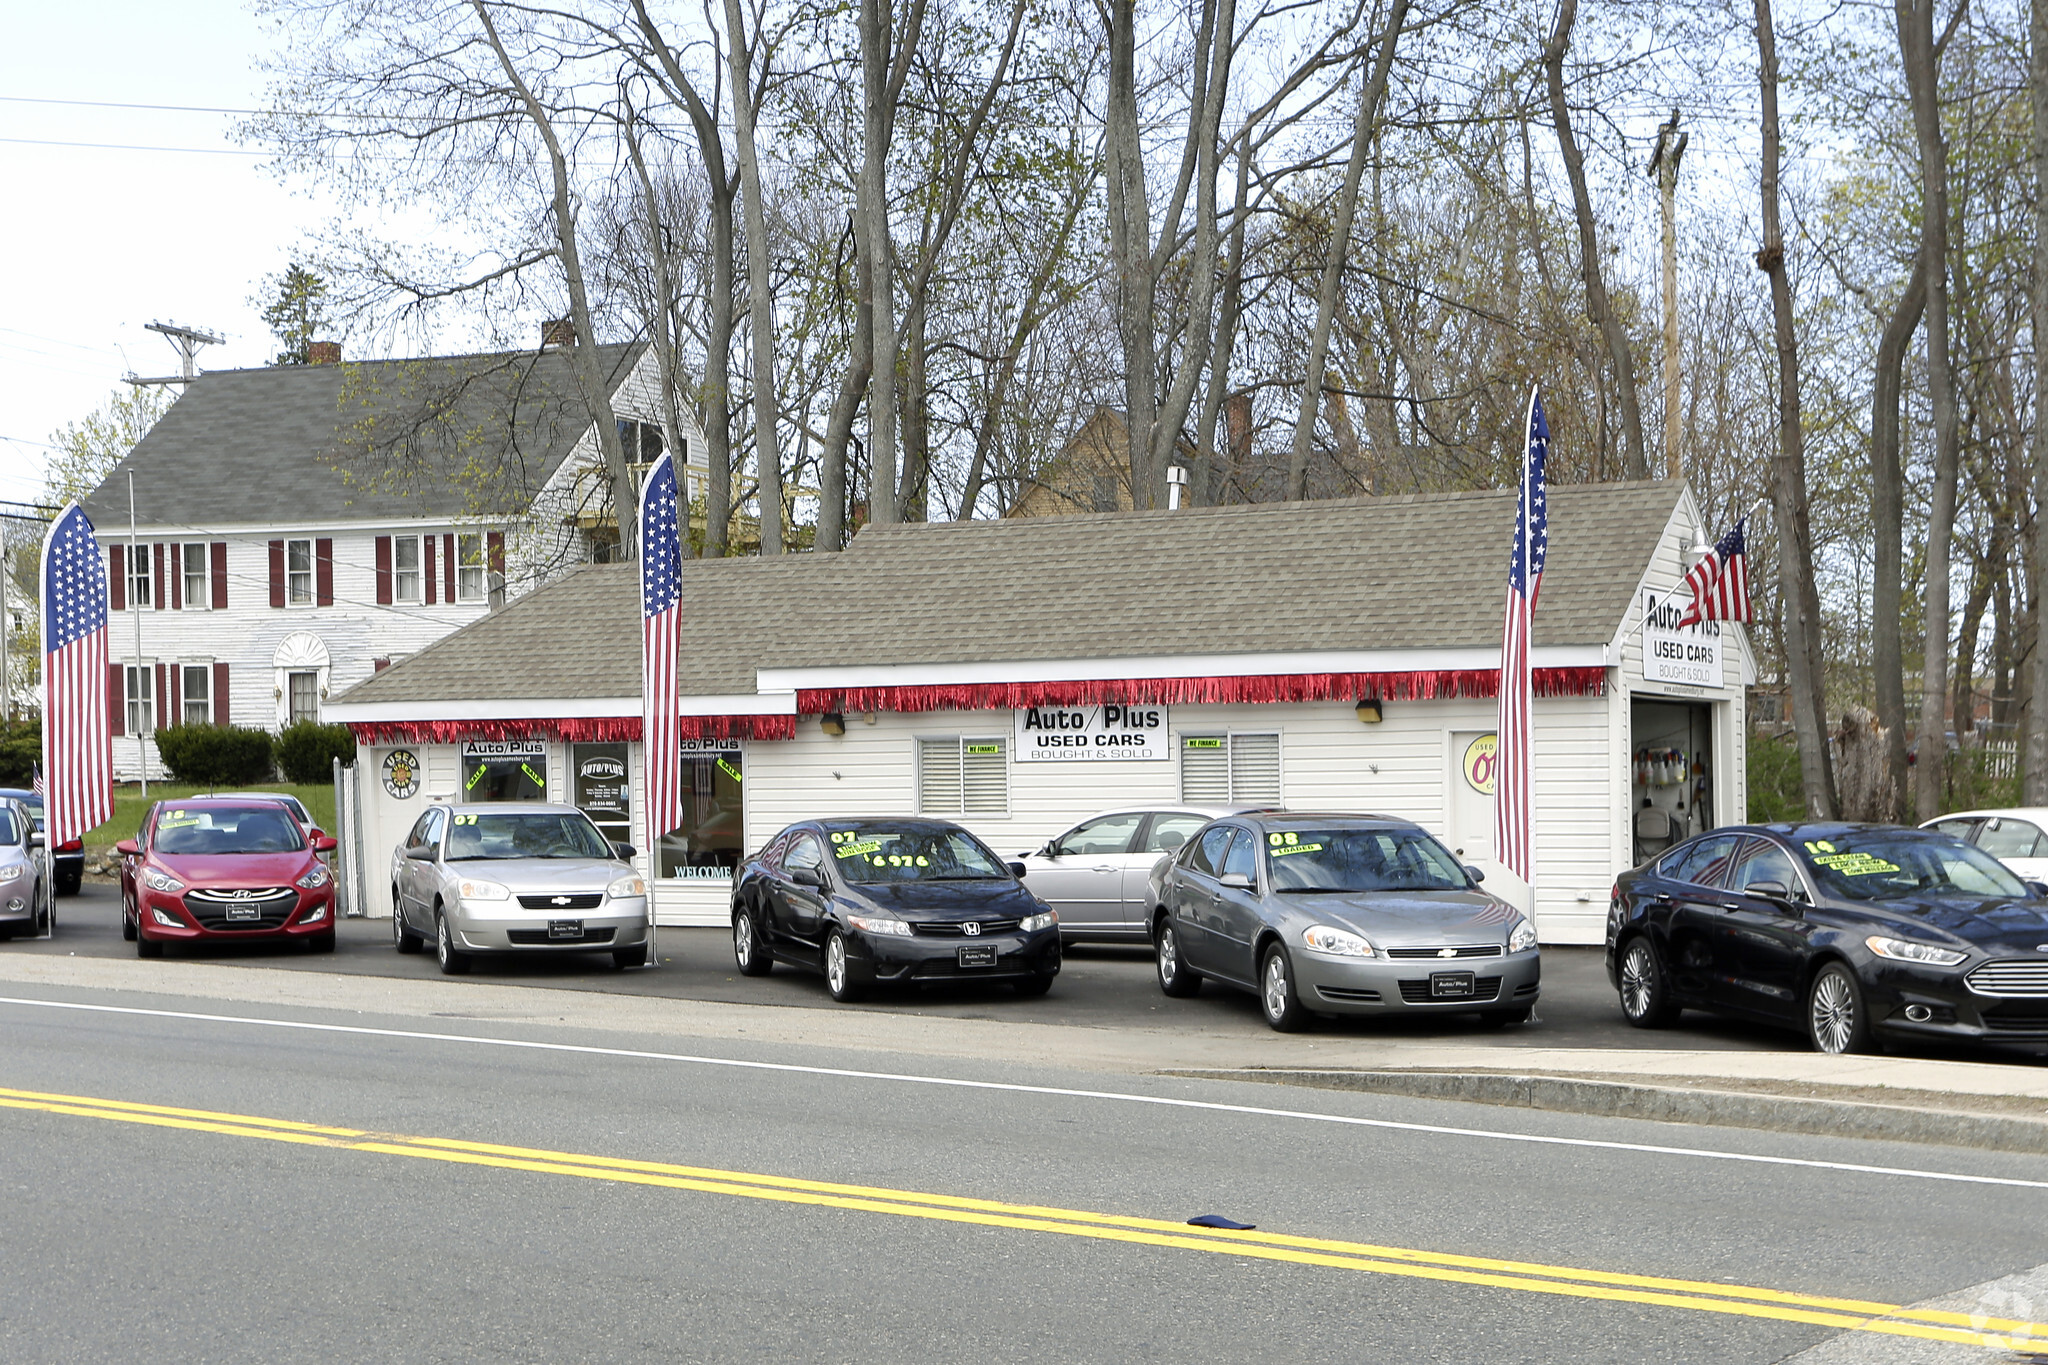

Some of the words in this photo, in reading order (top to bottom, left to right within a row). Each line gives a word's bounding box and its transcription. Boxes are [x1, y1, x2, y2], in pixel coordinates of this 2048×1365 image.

[1654, 640, 1684, 659] USED
[1686, 645, 1714, 664] CARS
[1659, 664, 1687, 679] BOUGHT
[1687, 668, 1693, 681] &
[1692, 669, 1710, 683] SOLD
[1023, 705, 1161, 732] Auto/Plus
[466, 741, 543, 754] Auto/Plus
[680, 739, 739, 750] to/Plus
[1037, 735, 1088, 747] USED
[1095, 734, 1146, 747] CARS
[386, 751, 417, 767] USED
[1031, 750, 1092, 759] BOUGHT
[1096, 750, 1107, 758] &
[1111, 749, 1153, 758] SOLD
[580, 763, 624, 777] AUTO/PLUS
[386, 781, 416, 798] CARS
[165, 810, 185, 820] 15
[454, 814, 478, 826] 07
[830, 831, 856, 844] 07
[1269, 832, 1299, 846] 08
[1278, 844, 1314, 854] LOADED
[1804, 841, 1836, 855] 14
[674, 865, 732, 879] WELCOME
